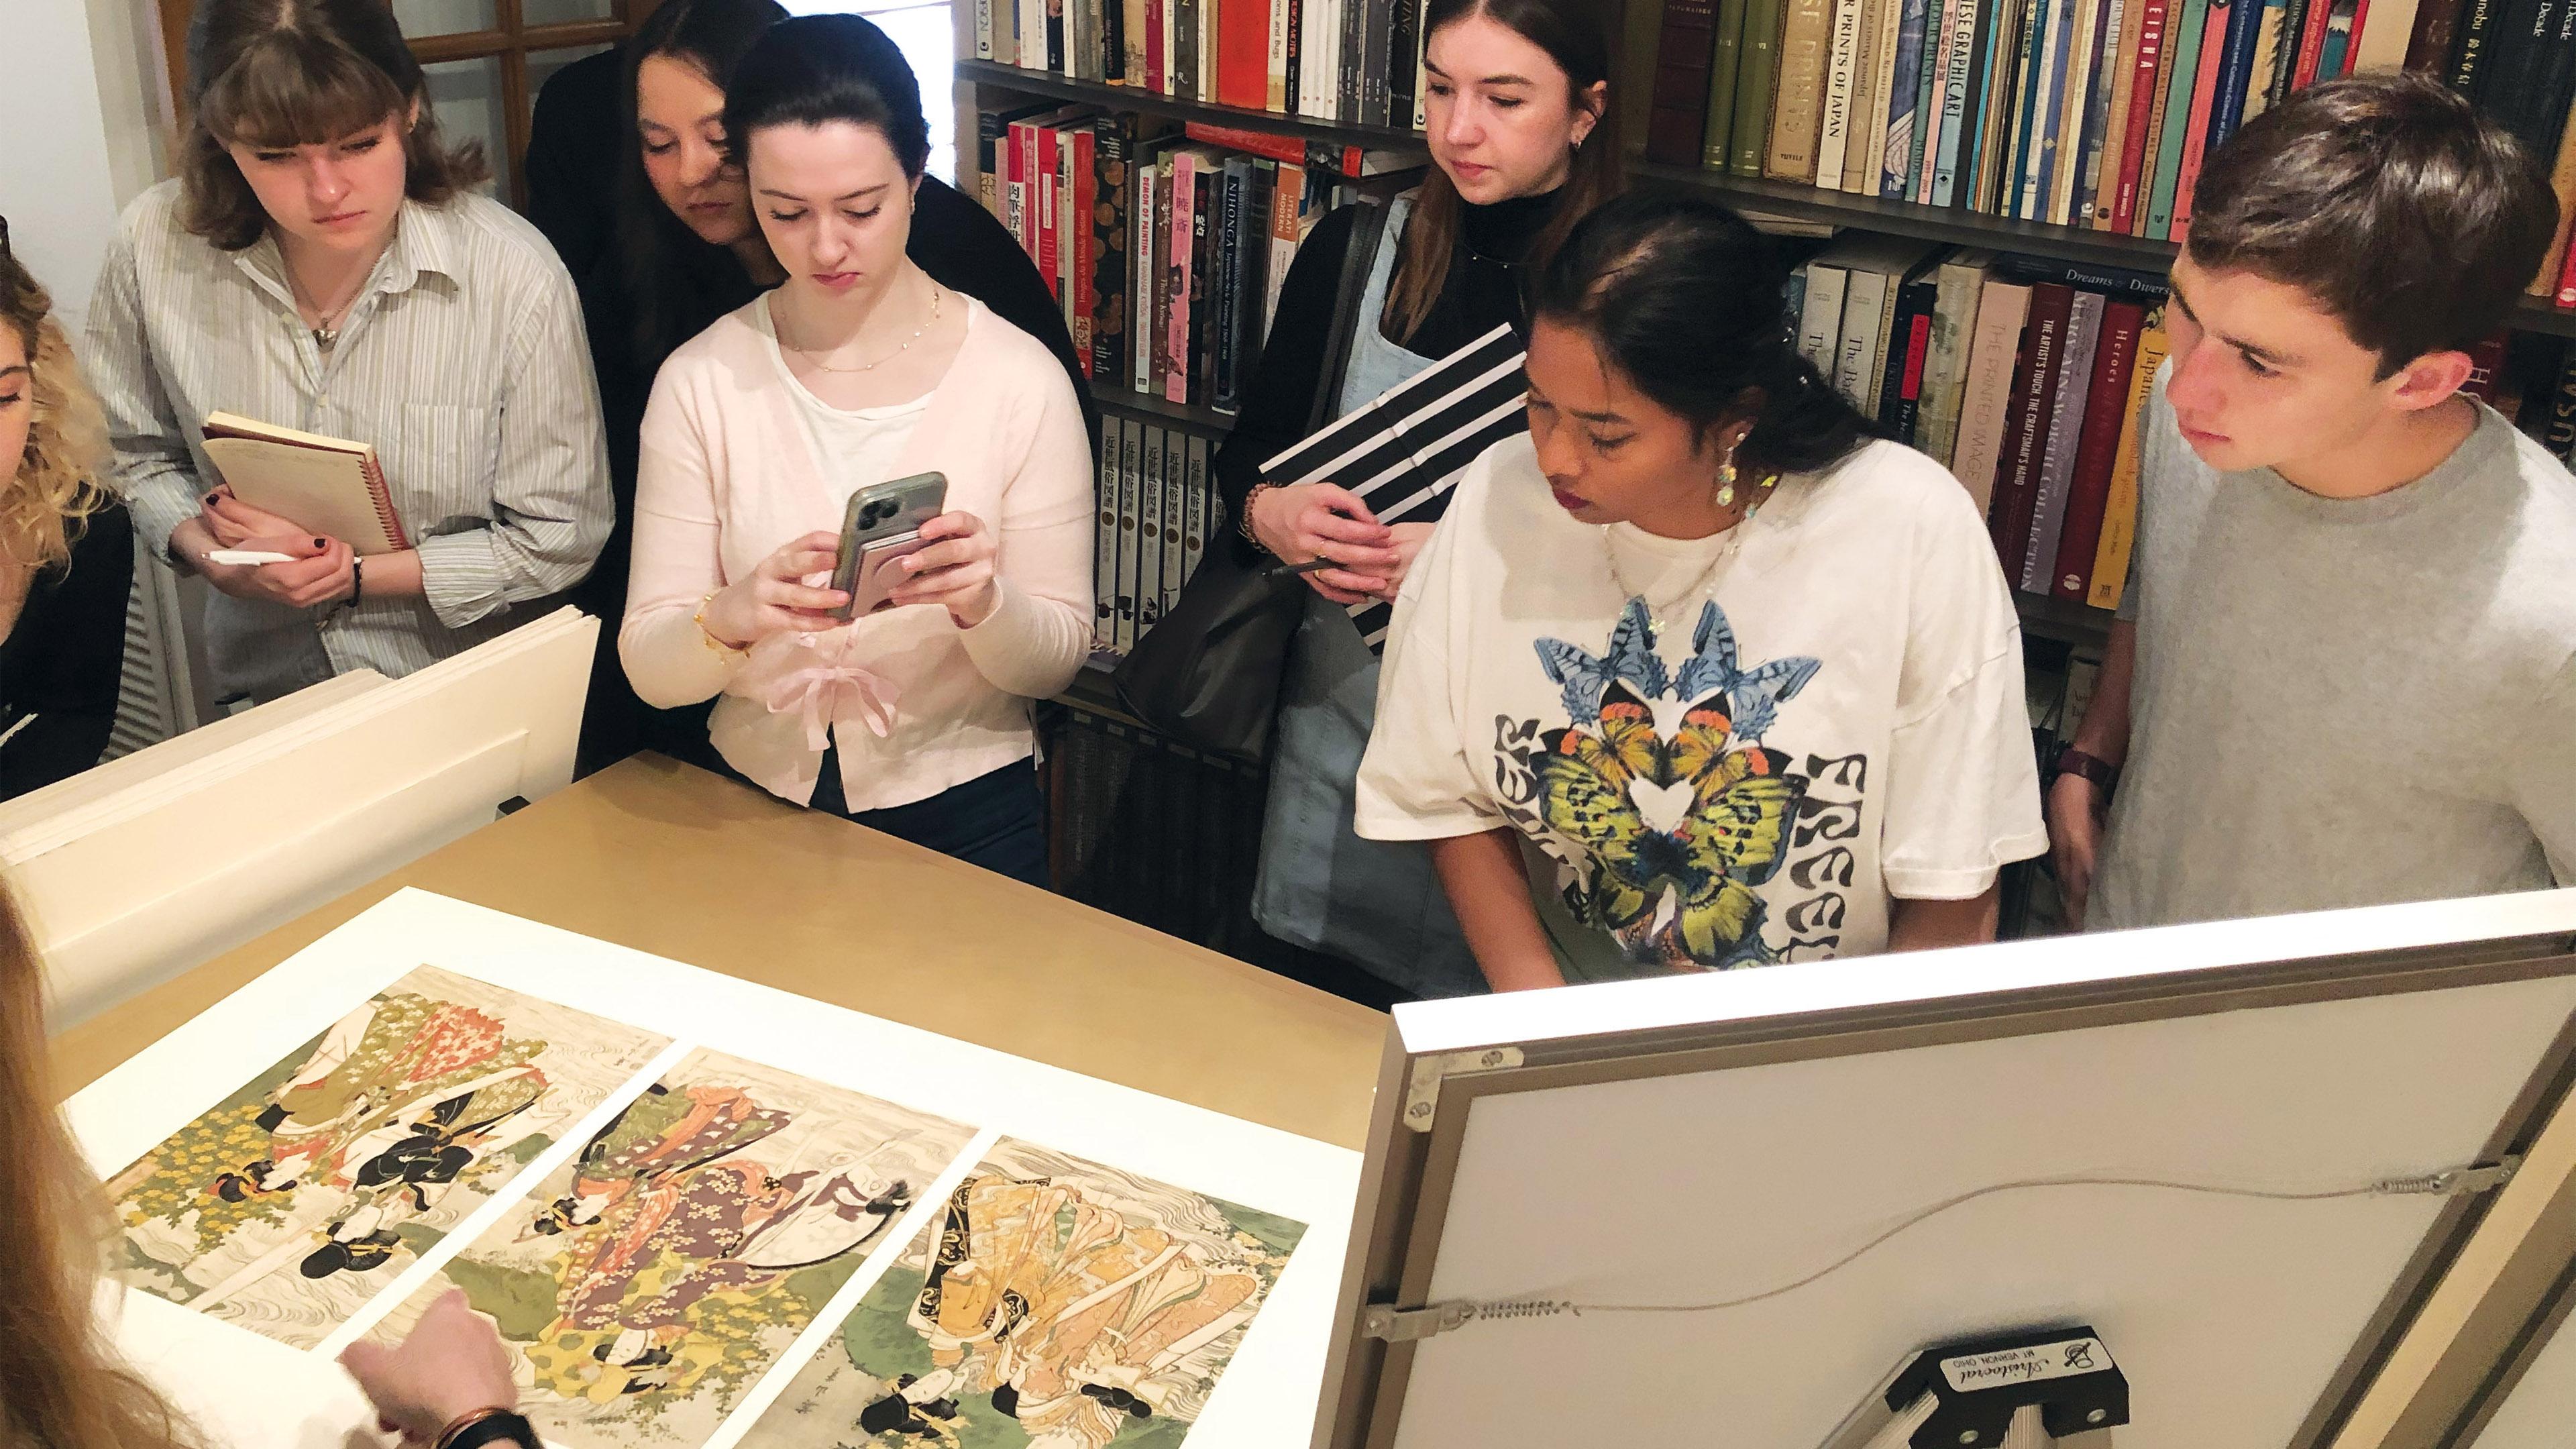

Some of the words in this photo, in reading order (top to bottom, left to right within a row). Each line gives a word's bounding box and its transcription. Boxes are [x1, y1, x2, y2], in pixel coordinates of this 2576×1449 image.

[1957, 0, 1975, 27] ESE
[2532, 2, 2553, 37] Decade
[2560, 6, 2576, 40] Decade
[1272, 40, 1280, 58] Bugs
[1835, 14, 1854, 66] PRINTS
[2305, 21, 2320, 50] popular
[1948, 31, 1970, 90] GRAPHIC
[2300, 52, 2313, 73] prints
[1834, 71, 1847, 89] OF
[1825, 95, 1844, 138] JAPAN
[1945, 93, 1961, 118] ART
[1142, 208, 1148, 217] OF
[1226, 182, 1236, 247] NIHONGA
[1277, 193, 1287, 232] MODERN
[1285, 195, 1295, 233] LITERATI
[2066, 269, 2113, 287] Dreams
[1222, 300, 1230, 326] Painting
[2041, 319, 2055, 334] THE
[2065, 290, 2084, 347] MARY
[1845, 335, 1863, 364] The
[1989, 322, 2007, 352] THE
[2035, 334, 2051, 368] ARTIST'S
[2107, 329, 2128, 384] Heroes
[1974, 357, 2001, 426] PRINTED
[2029, 368, 2045, 396] TOUCH,
[1902, 403, 1911, 419] The
[2027, 397, 2039, 412] THE
[2042, 354, 2073, 468] AINSWORTH
[2017, 413, 2036, 464] CRAFTSMAN'S
[1965, 431, 1988, 480] IMAGE
[2013, 464, 2026, 485] HAND
[2019, 475, 2051, 592] COLLECTION
[1786, 752, 1868, 965] FREEL
[1953, 1358, 1978, 1368] OHIO
[1960, 1358, 2050, 1384] Aristocrat
